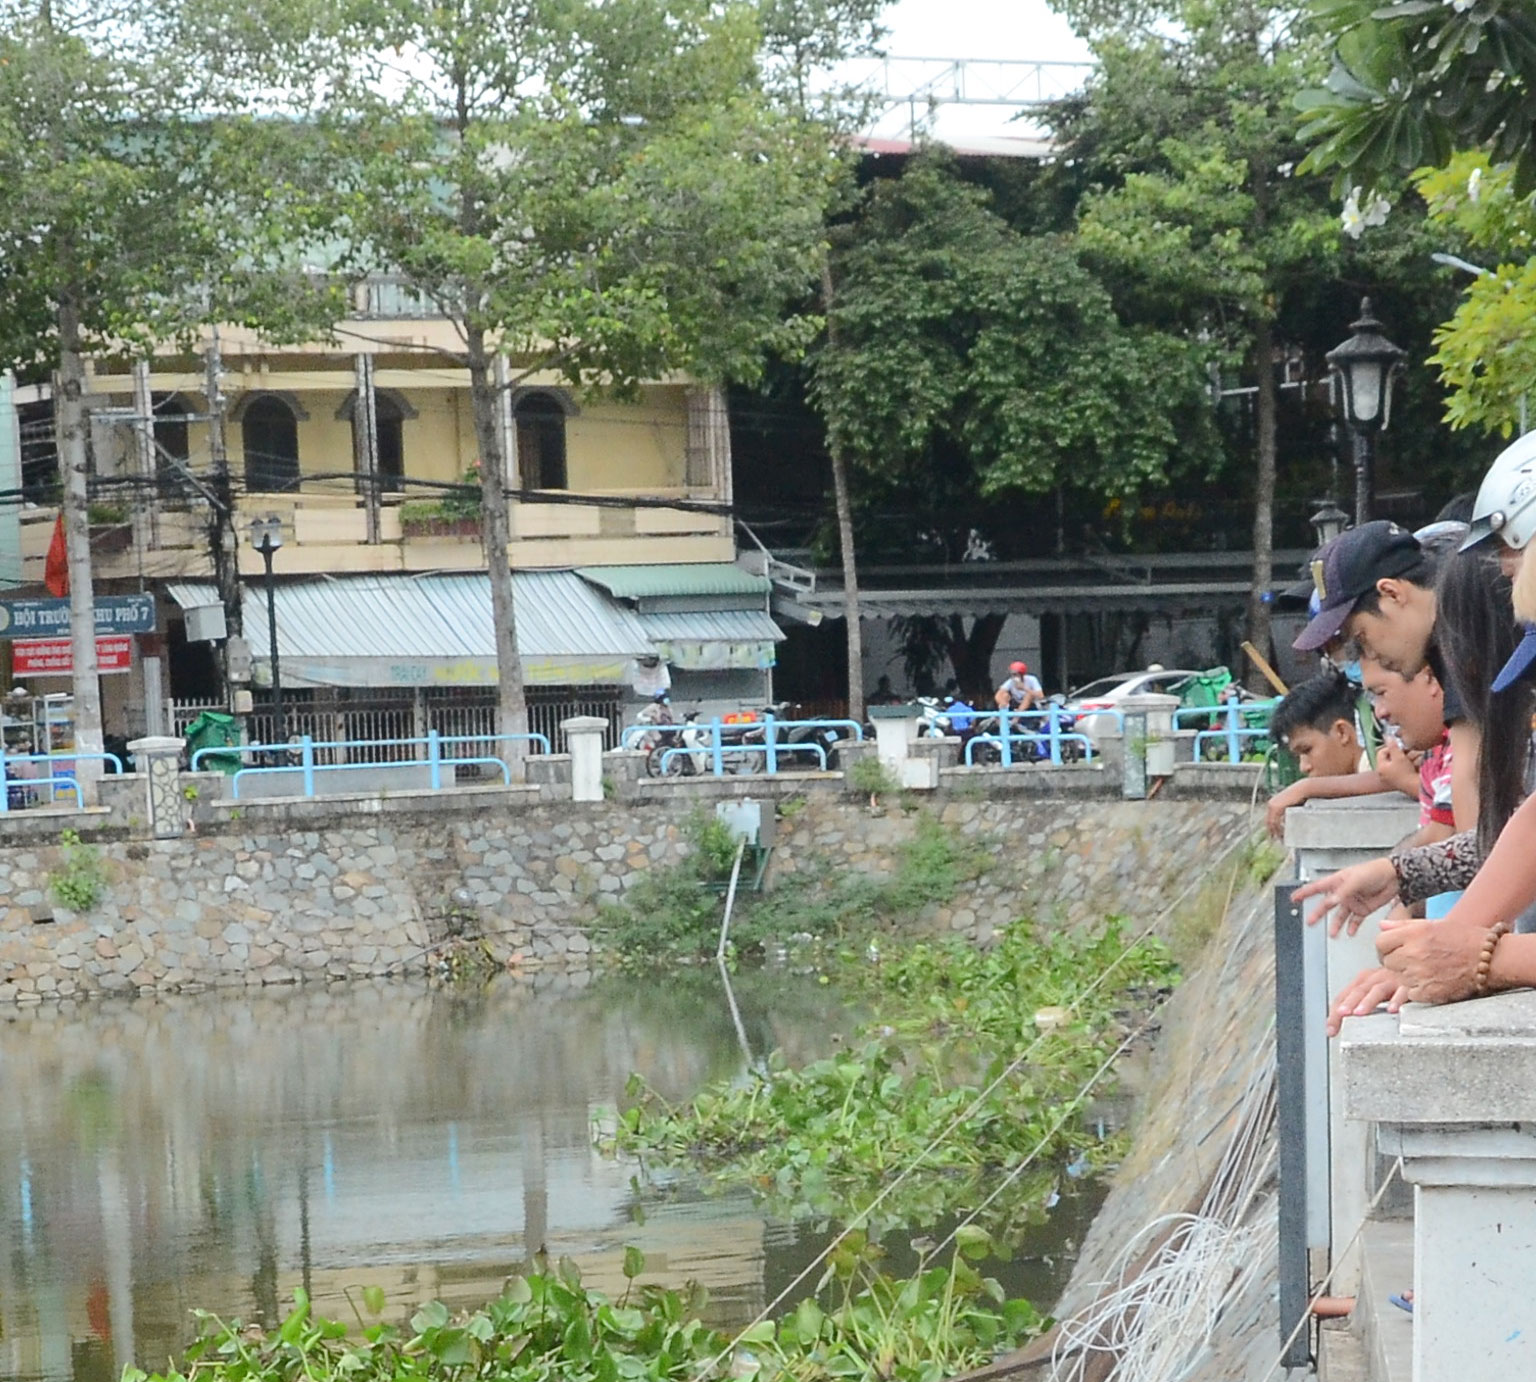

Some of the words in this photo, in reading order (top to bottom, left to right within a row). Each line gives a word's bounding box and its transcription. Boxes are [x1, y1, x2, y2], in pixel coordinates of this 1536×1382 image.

[14, 607, 36, 628] HỘI
[39, 606, 72, 625] TRƯỜ
[115, 602, 139, 622] PHỐ
[140, 606, 150, 621] 7
